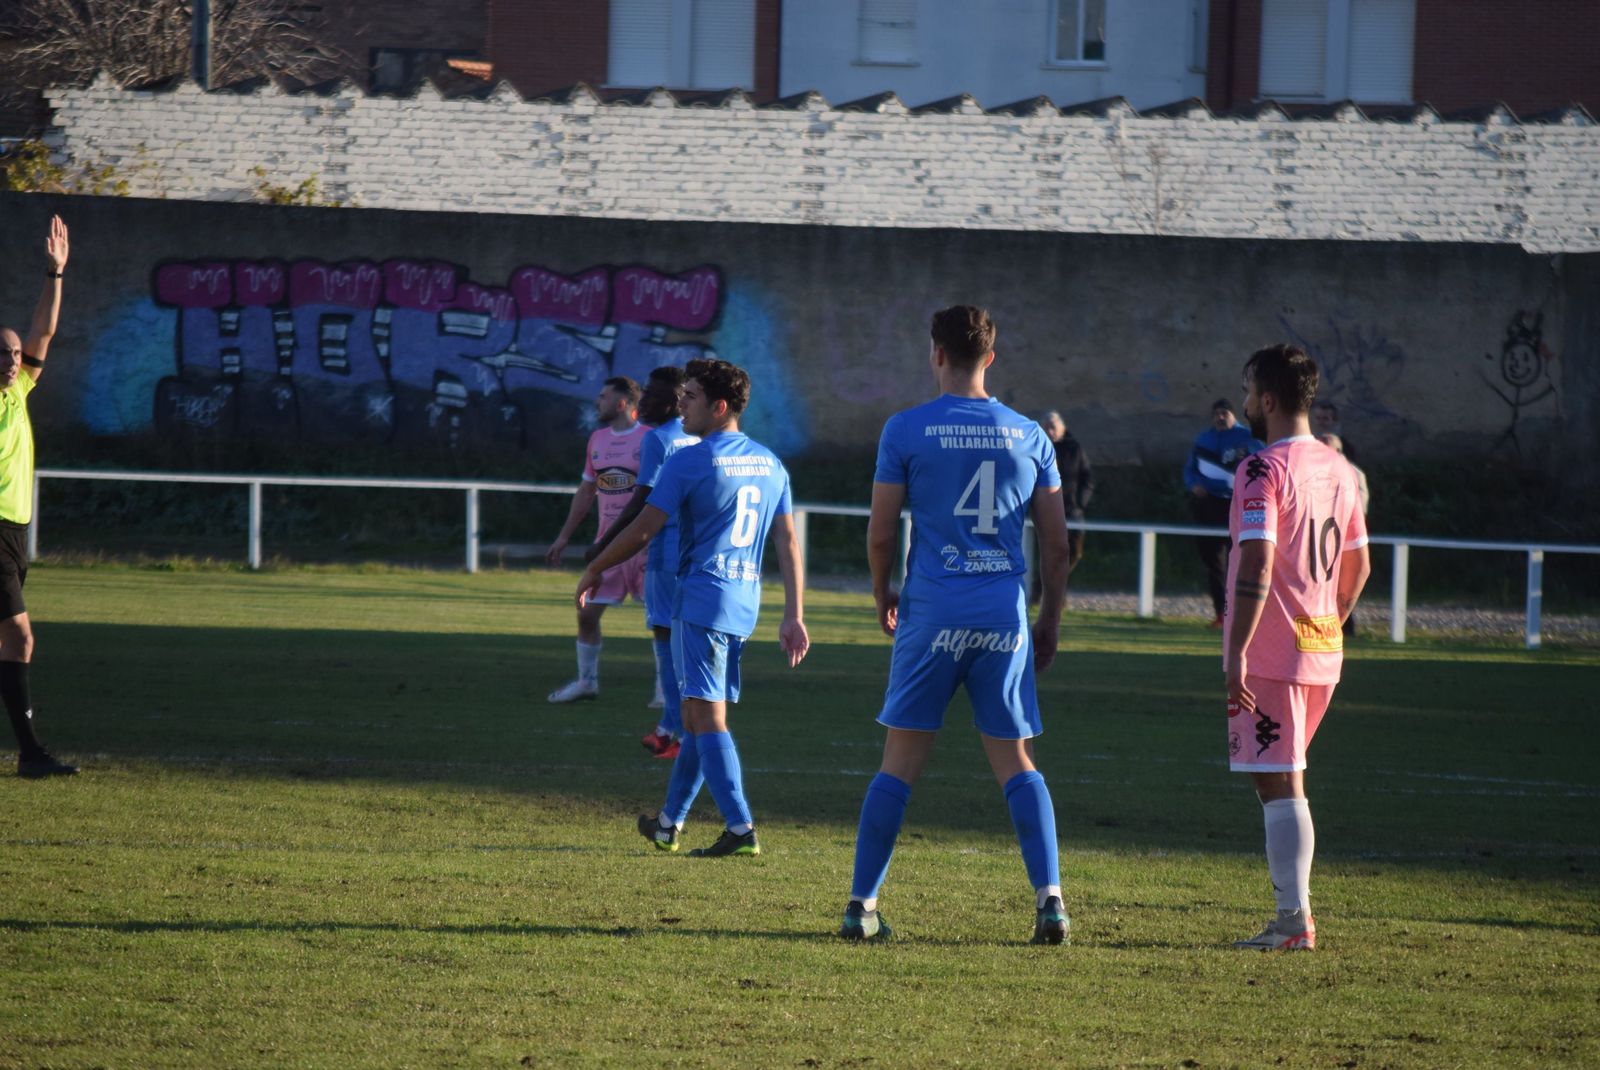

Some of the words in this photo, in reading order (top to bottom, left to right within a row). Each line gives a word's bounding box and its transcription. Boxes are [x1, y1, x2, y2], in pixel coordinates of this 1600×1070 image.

[925, 424, 1009, 437] AYUNTAMIENTO
[1011, 428, 1025, 440] DE
[940, 437, 1013, 450] VILLARALBO
[953, 460, 1000, 535] 4
[730, 485, 761, 548] 6
[1308, 516, 1341, 583] 10
[963, 560, 1013, 573] ZAMORA
[931, 629, 1024, 662] Alfonso
